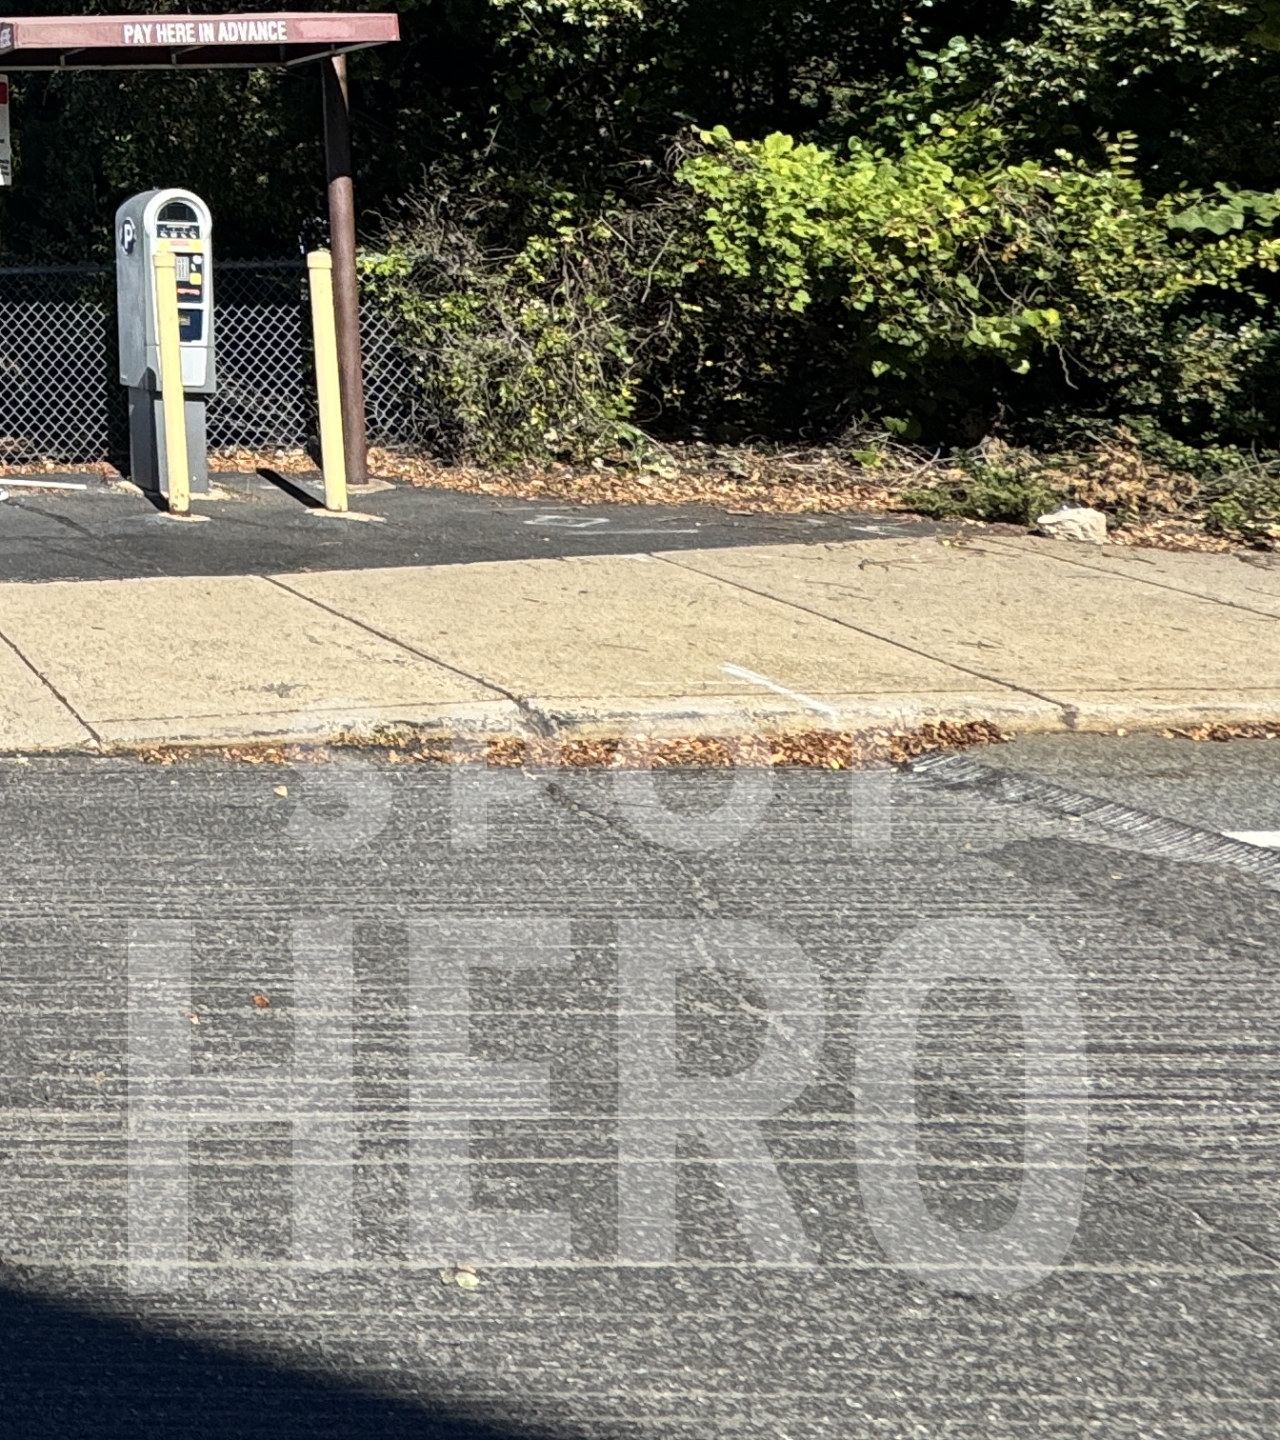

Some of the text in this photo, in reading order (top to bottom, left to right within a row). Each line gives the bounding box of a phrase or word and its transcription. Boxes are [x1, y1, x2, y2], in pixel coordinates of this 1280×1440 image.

[124, 20, 287, 44] PAY HERE IN ADVANCE
[123, 224, 133, 249] P
